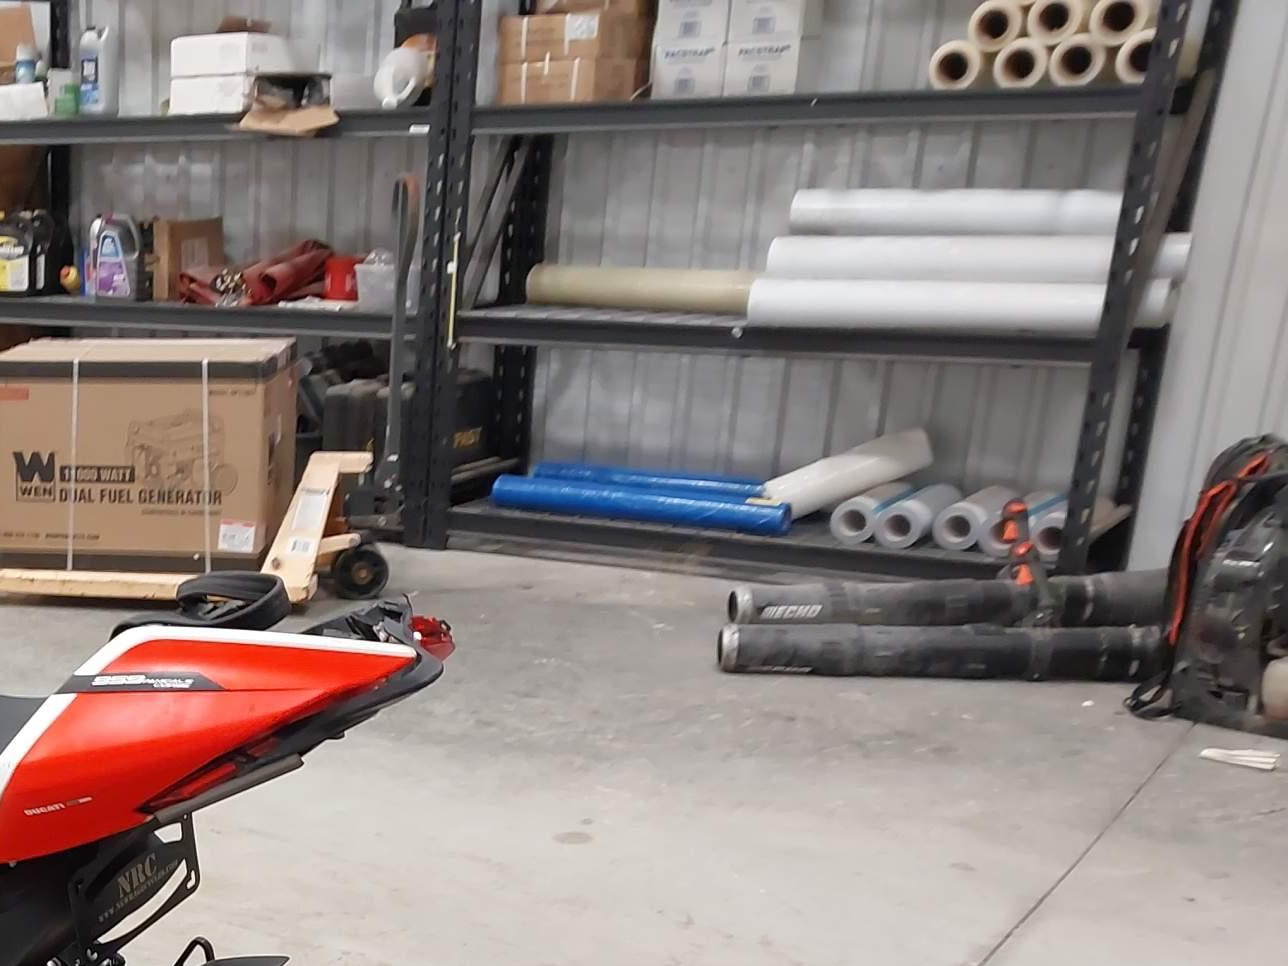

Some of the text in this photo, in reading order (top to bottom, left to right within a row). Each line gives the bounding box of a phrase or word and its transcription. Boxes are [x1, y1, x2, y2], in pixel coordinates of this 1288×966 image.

[99, 467, 132, 481] WATT
[20, 486, 53, 497] WEN
[99, 488, 133, 504] FUEL
[24, 802, 66, 816] DUCATI
[118, 852, 156, 899] NRC
